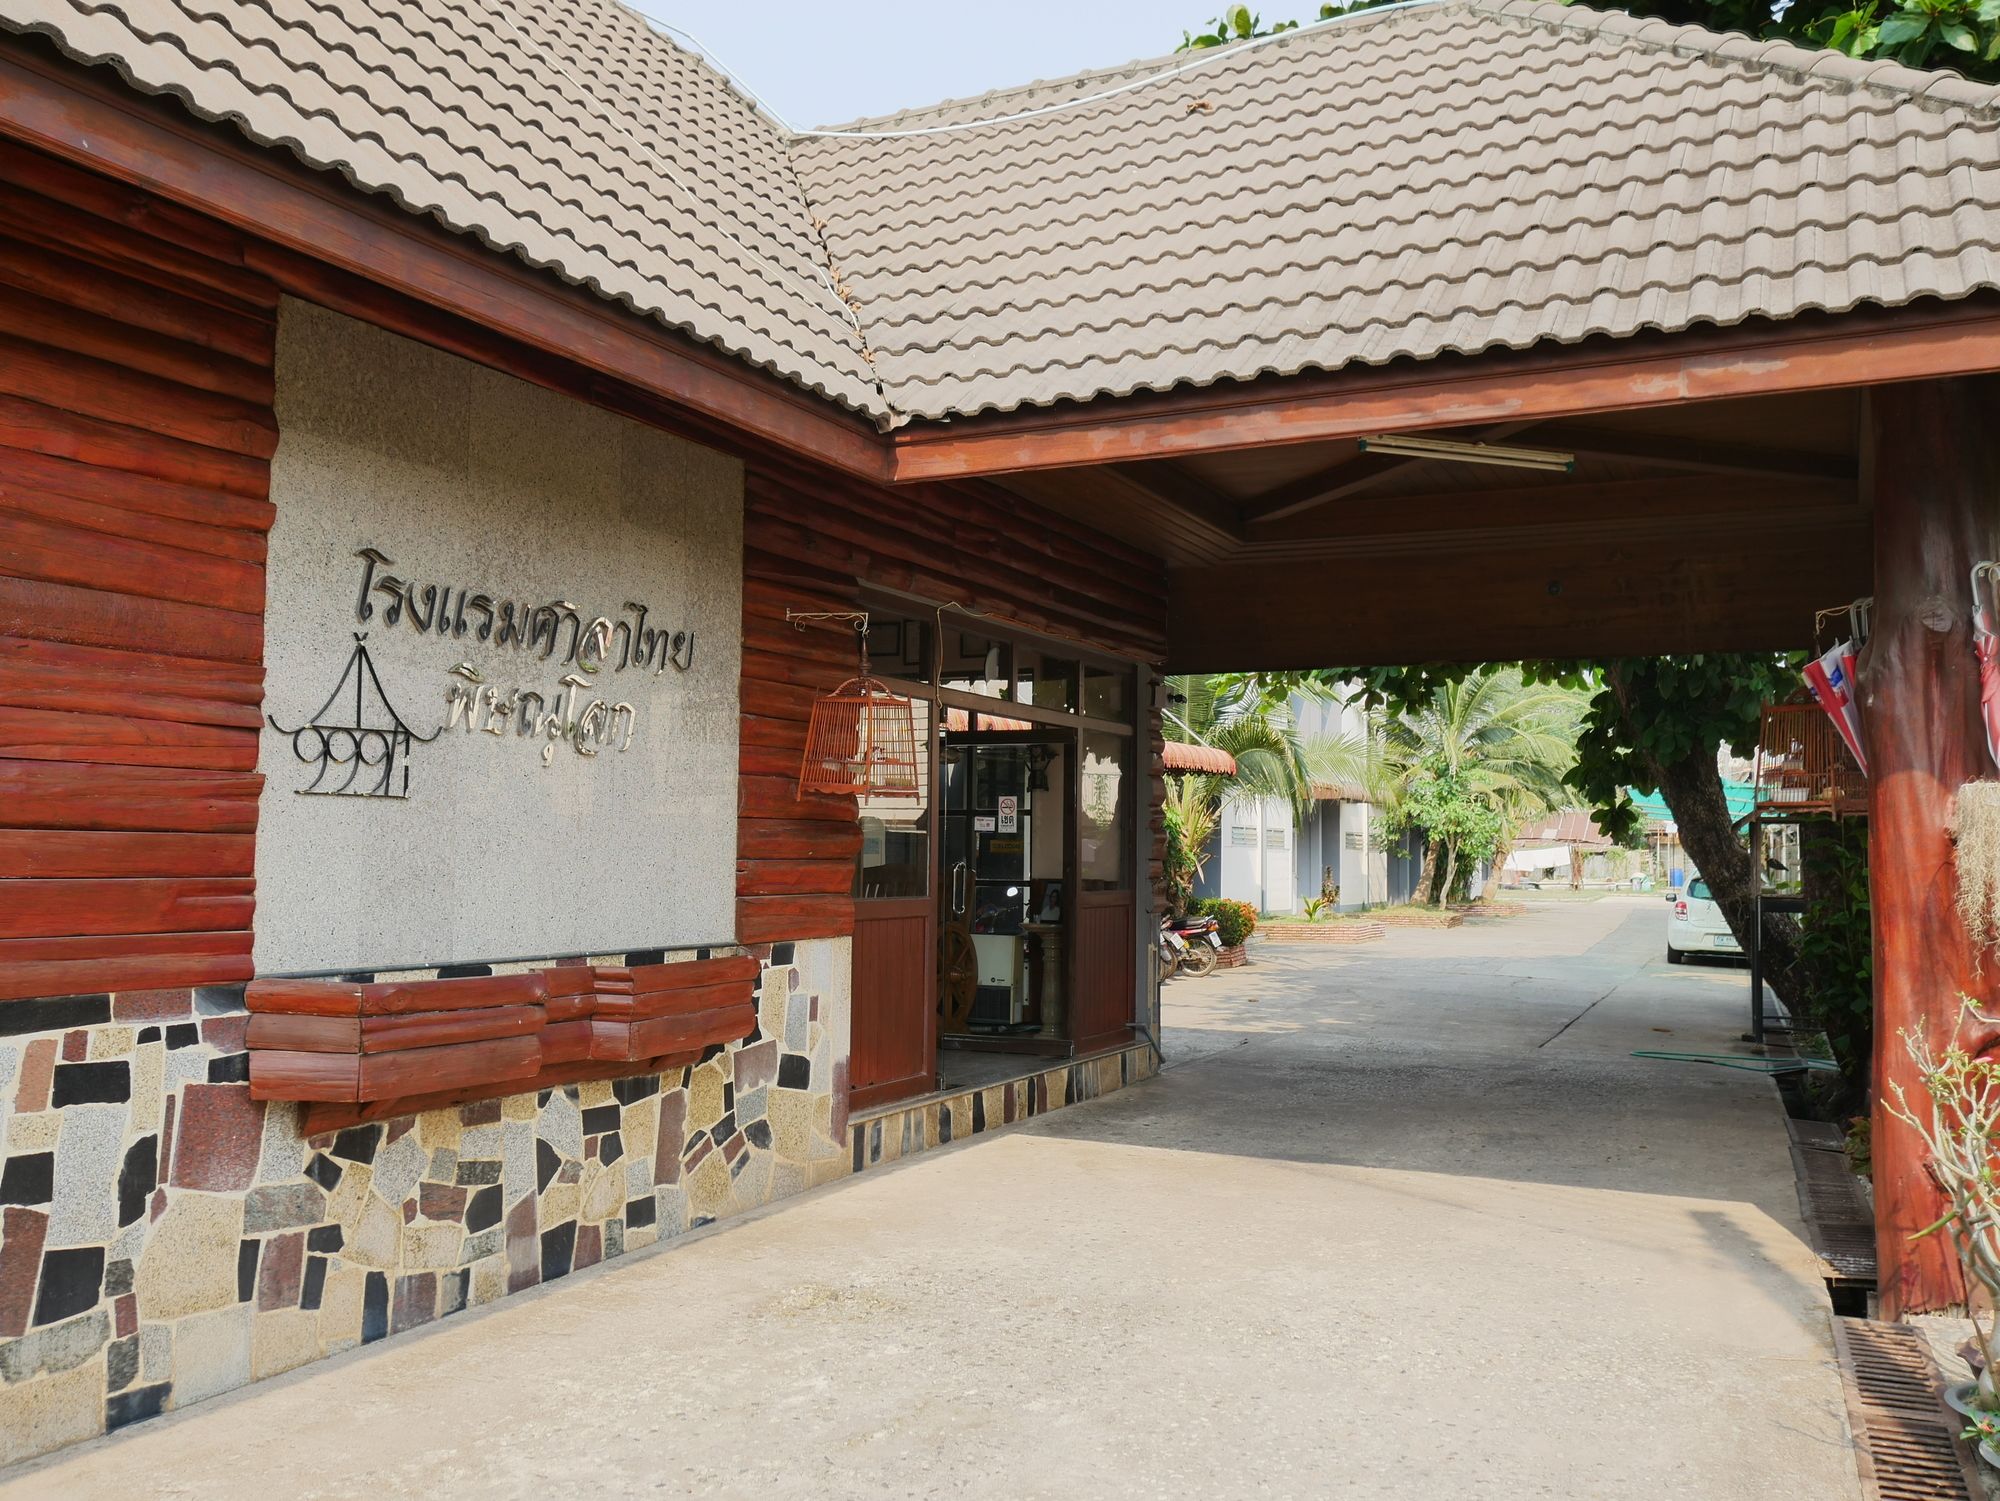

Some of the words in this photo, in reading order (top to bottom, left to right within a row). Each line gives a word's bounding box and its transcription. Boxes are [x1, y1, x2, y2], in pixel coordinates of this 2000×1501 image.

[353, 547, 696, 675] โรงแรมศาลาไทย
[444, 662, 636, 768] พิษณุโลก
